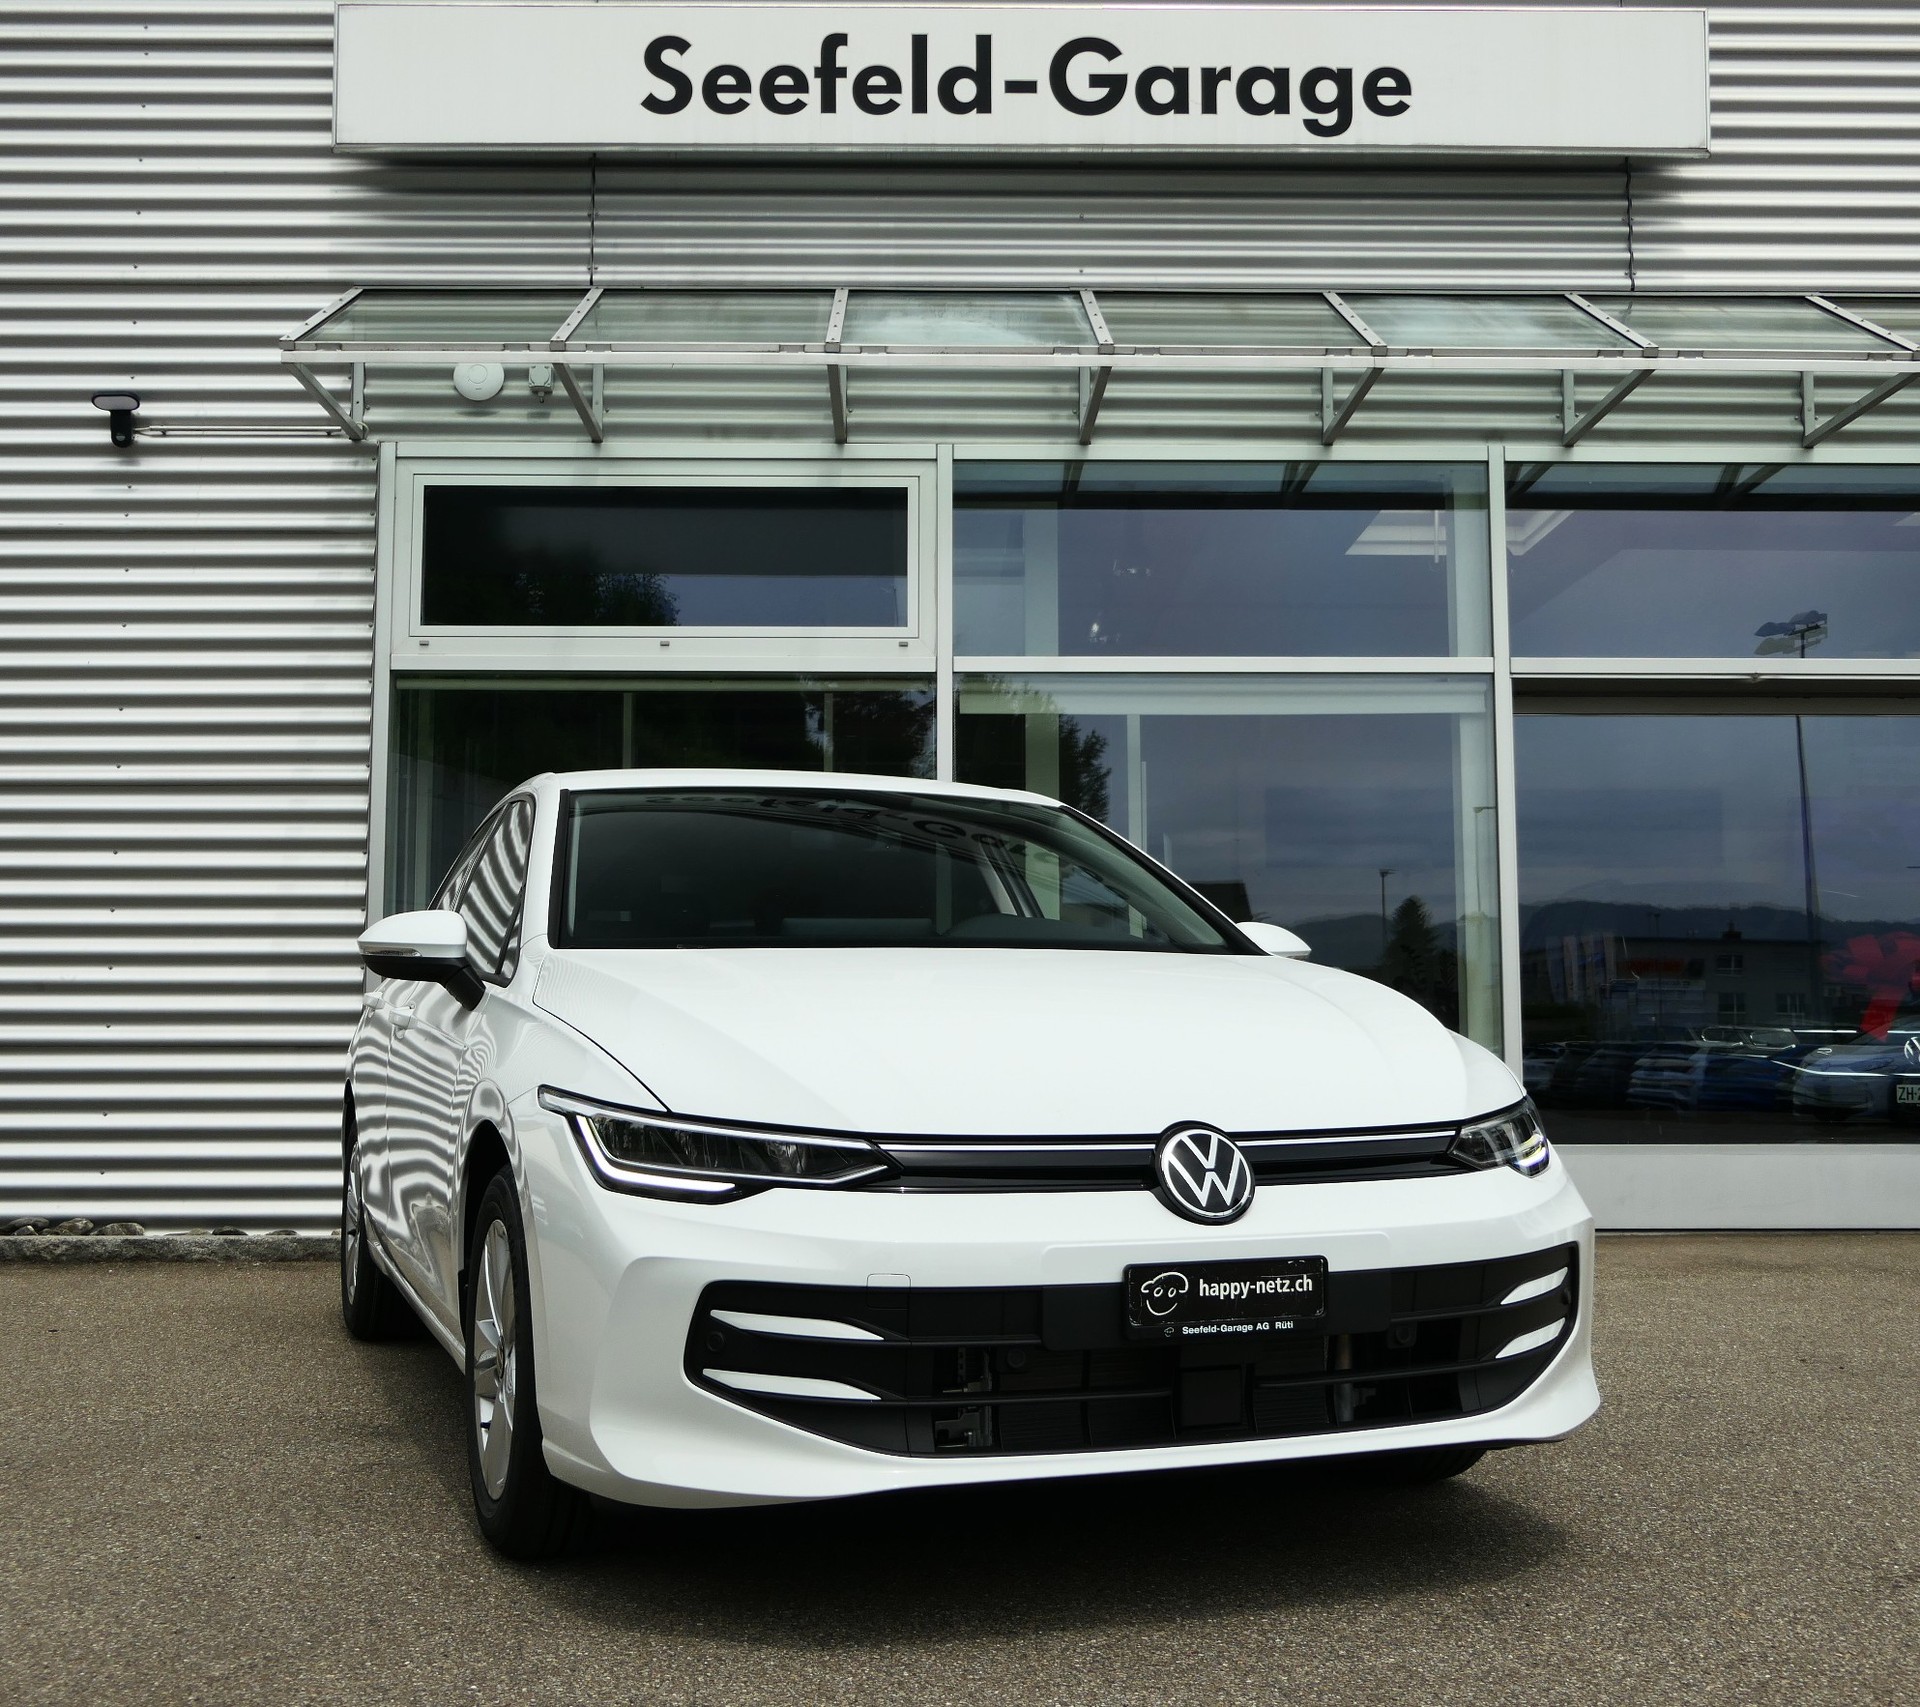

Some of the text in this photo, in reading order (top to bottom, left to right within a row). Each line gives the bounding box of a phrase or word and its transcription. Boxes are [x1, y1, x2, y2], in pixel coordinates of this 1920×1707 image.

[640, 33, 1413, 138] Seefeld-Garage
[1163, 1131, 1247, 1213] VW
[1199, 1275, 1313, 1300] happy-netz.ch
[1182, 1320, 1294, 1335] Seefeld-Garage AG Rüti
